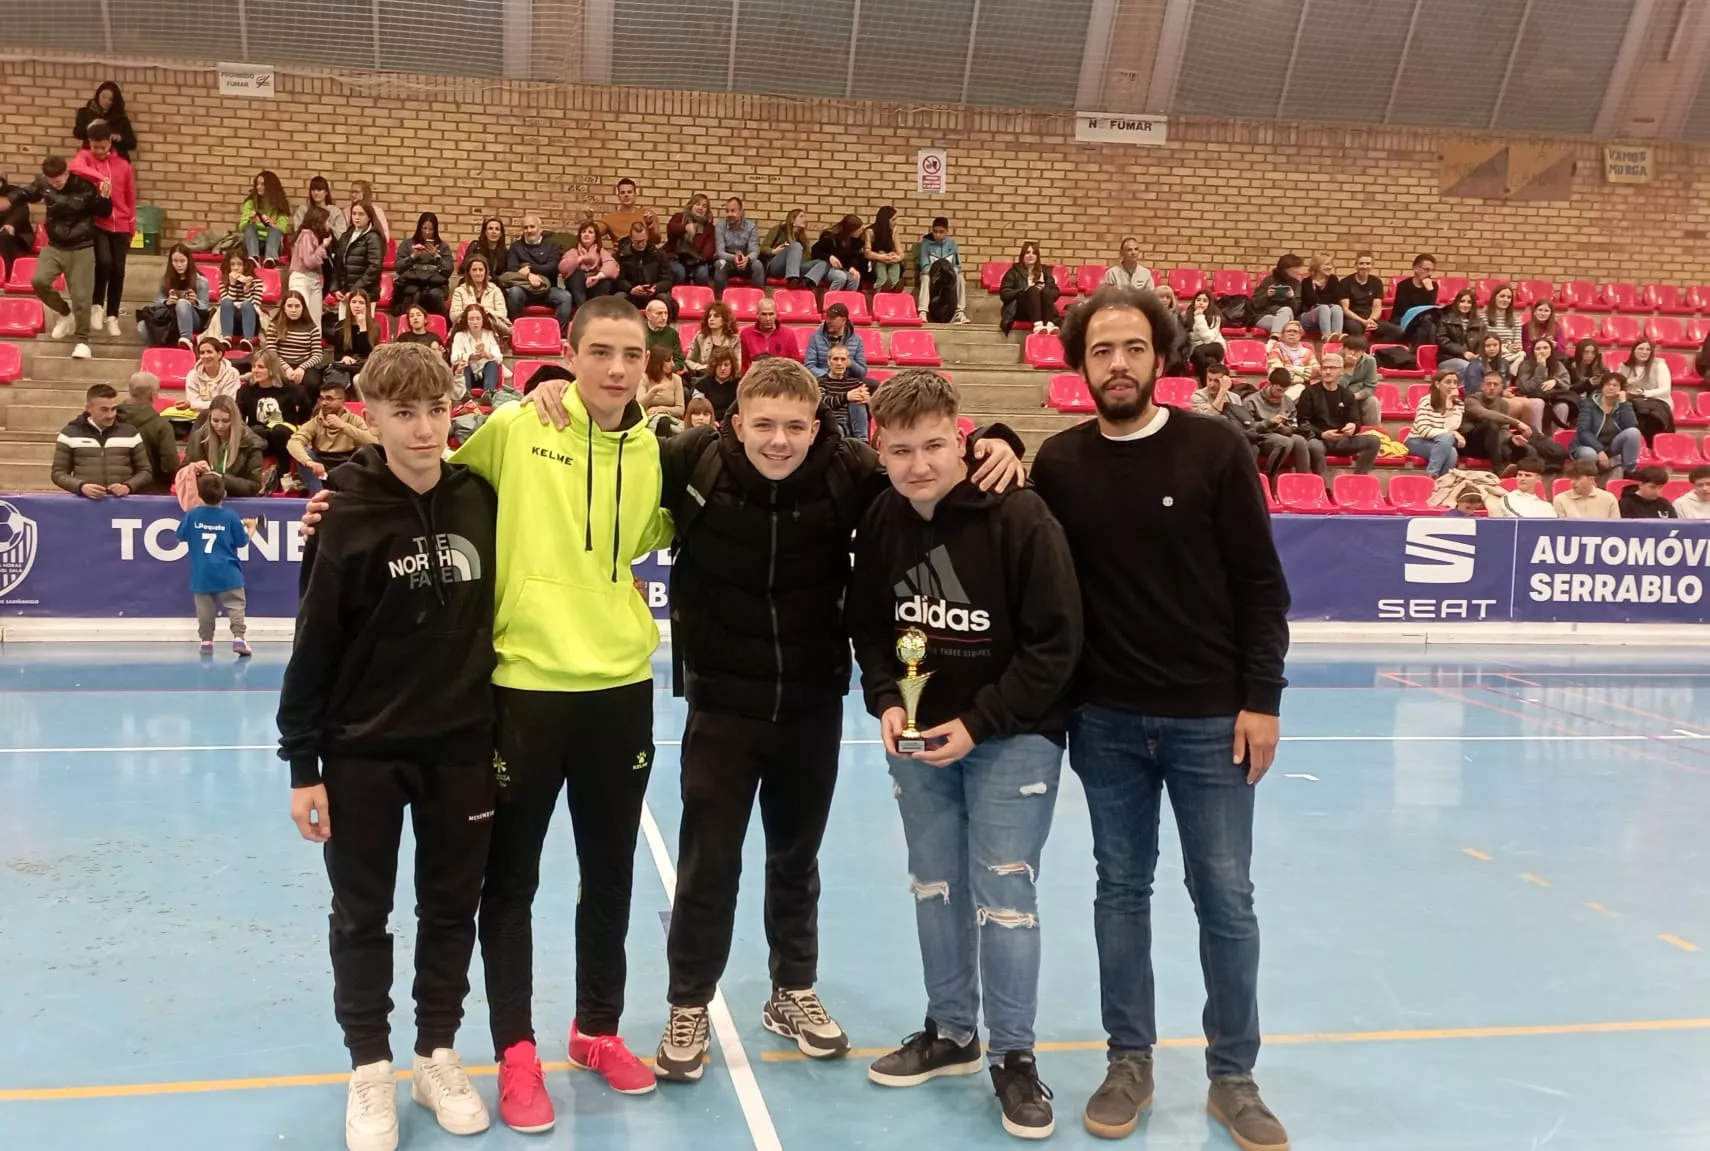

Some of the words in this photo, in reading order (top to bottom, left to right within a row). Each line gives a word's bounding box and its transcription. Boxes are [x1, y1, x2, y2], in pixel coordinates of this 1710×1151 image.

[1110, 120, 1152, 131] FUMAR
[1609, 150, 1646, 162] VAMOS
[532, 446, 574, 466] KELME
[112, 518, 303, 561] TONE
[202, 532, 217, 553] 7
[388, 549, 452, 579] NORH
[410, 566, 454, 590] FAE
[1529, 572, 1703, 604] SERRABLO
[895, 594, 991, 631] didas
[1378, 599, 1497, 618] SEAT
